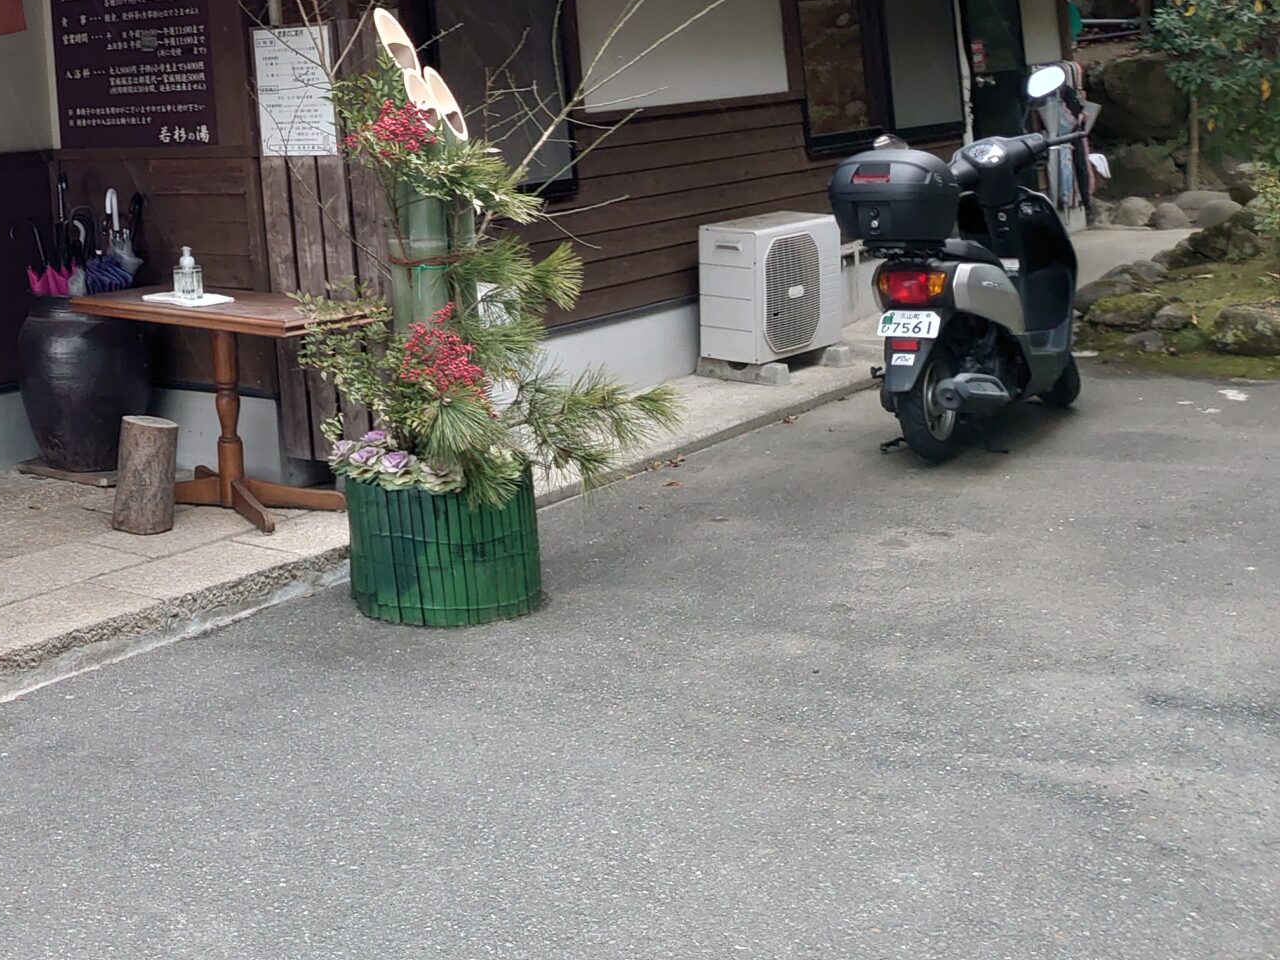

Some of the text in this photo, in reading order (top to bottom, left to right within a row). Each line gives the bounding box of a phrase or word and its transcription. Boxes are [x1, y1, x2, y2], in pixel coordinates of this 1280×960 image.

[62, 33, 88, 44] 営業時間
[66, 67, 90, 79] 入浴料
[159, 126, 209, 143] 若杉の湯
[892, 321, 932, 334] 7561
